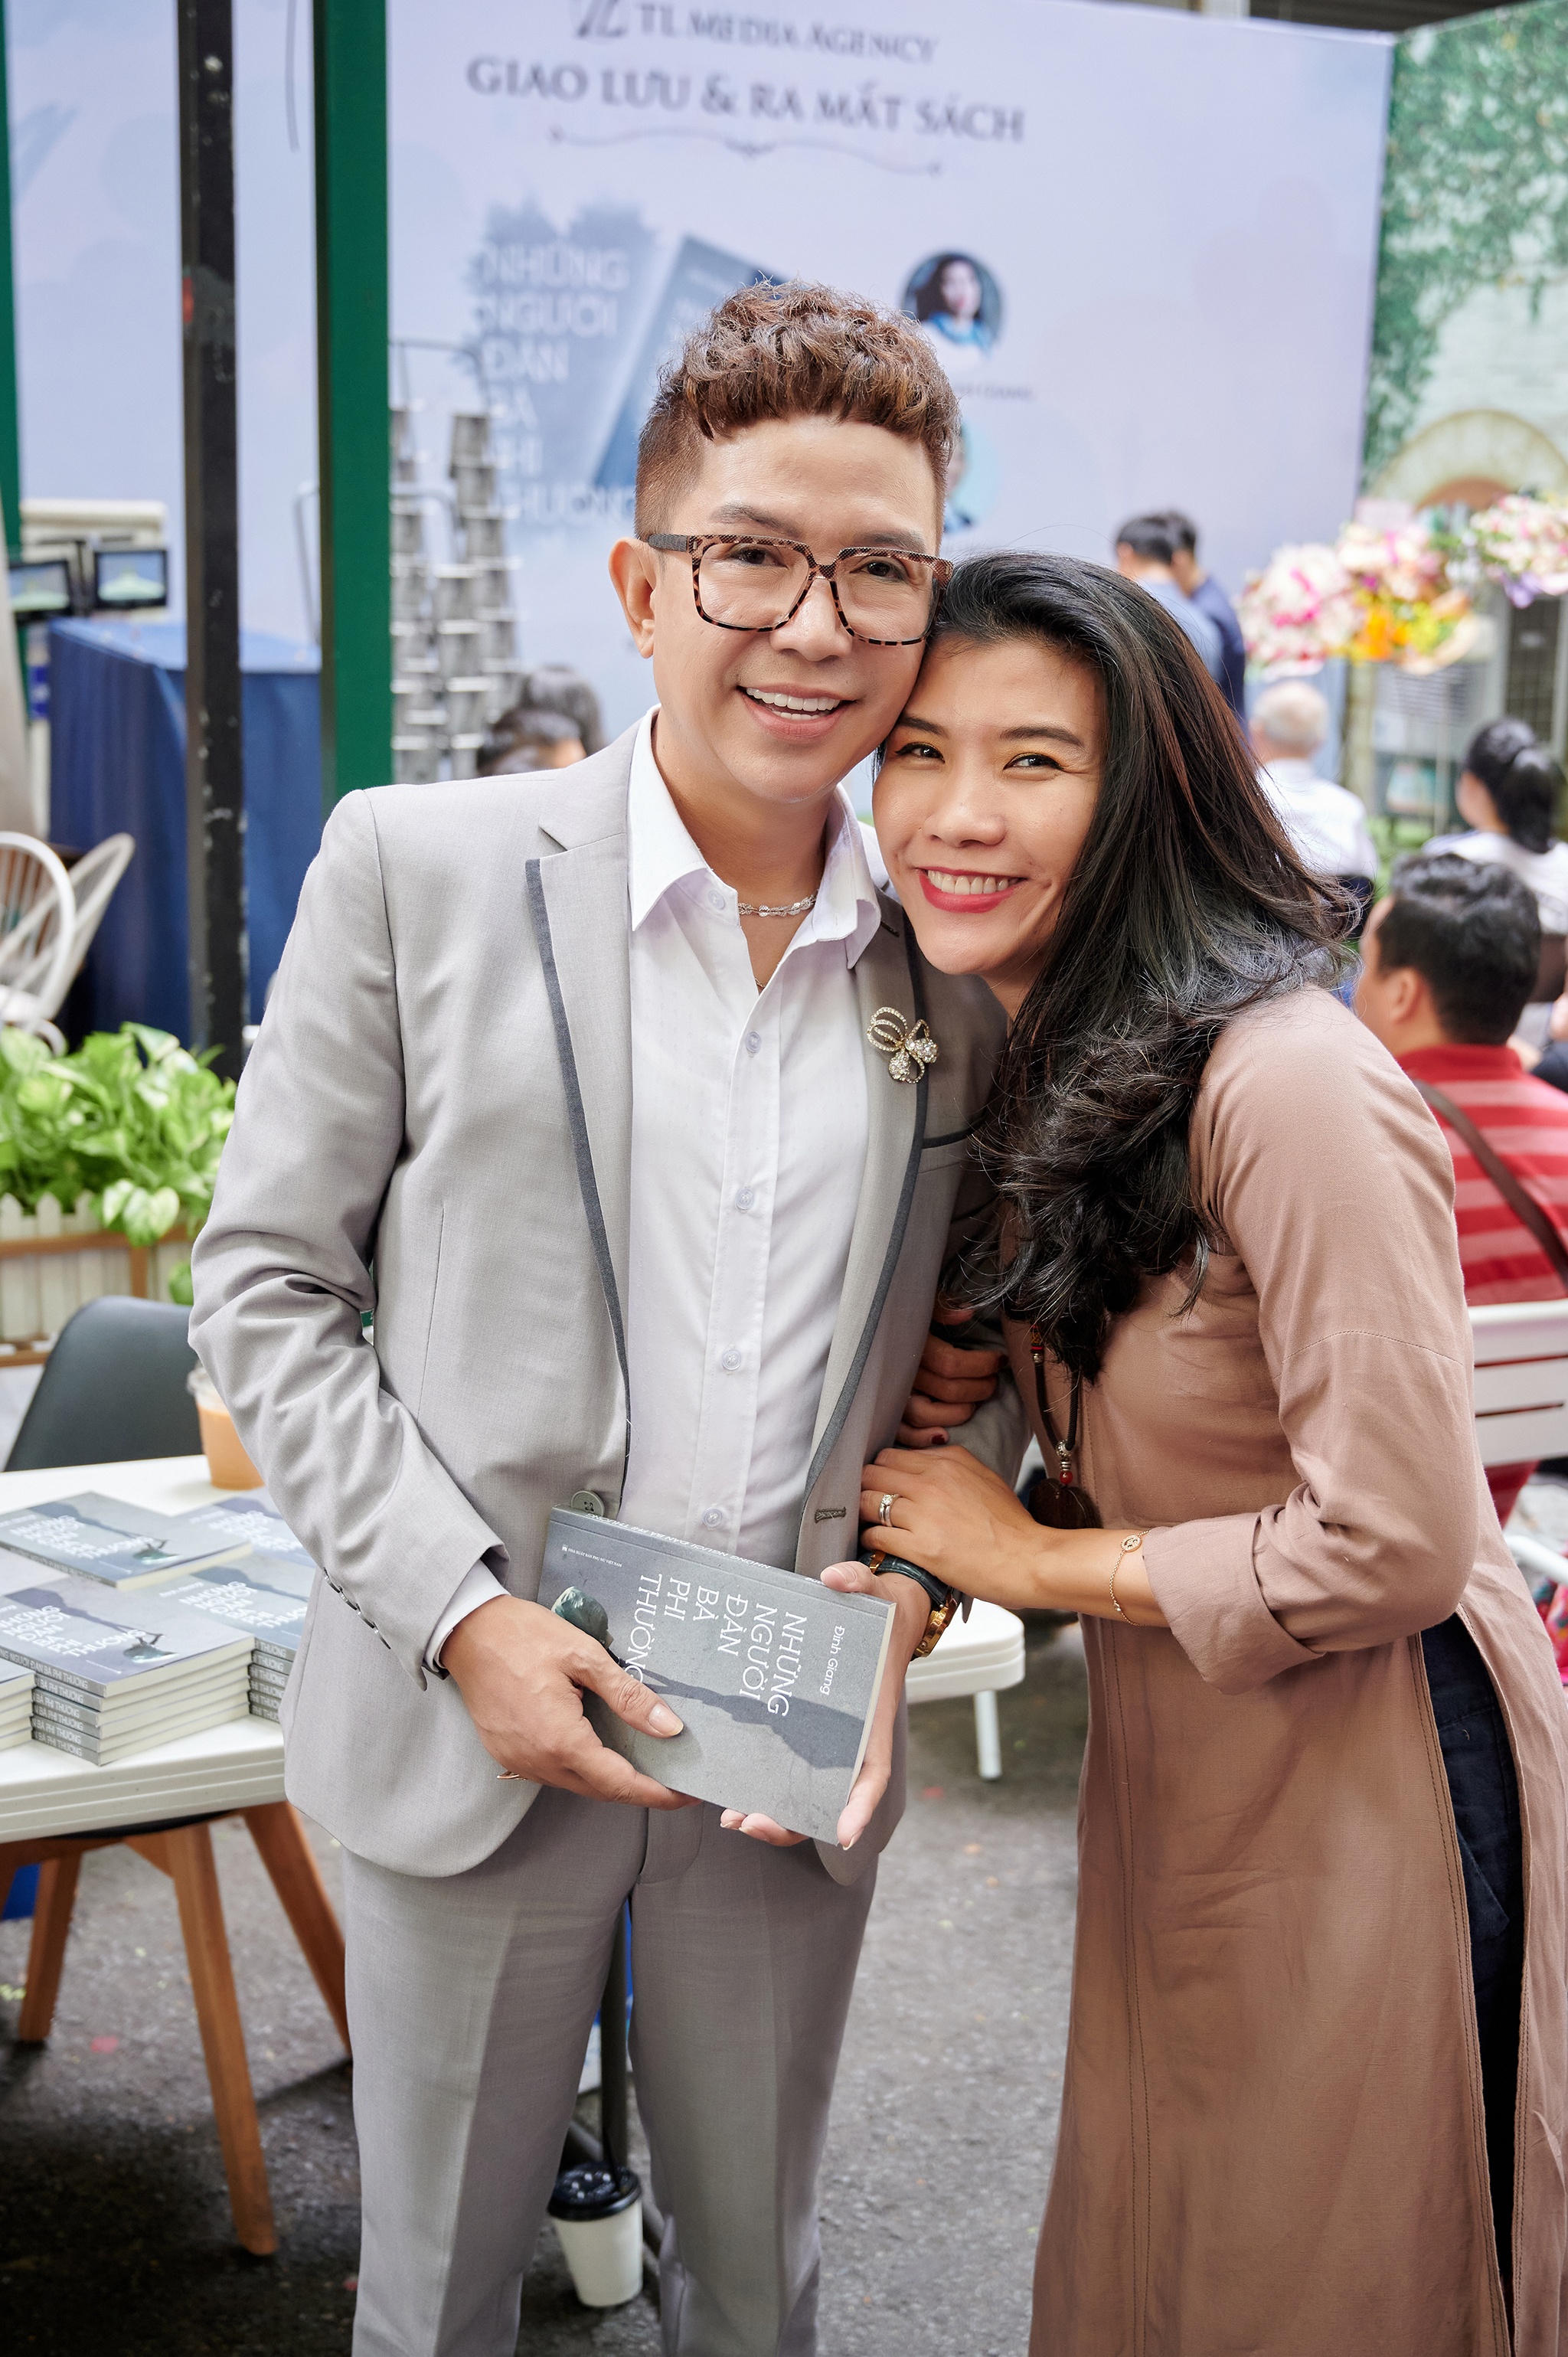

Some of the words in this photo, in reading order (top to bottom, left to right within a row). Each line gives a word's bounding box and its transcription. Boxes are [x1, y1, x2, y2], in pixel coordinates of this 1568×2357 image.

[688, 11, 800, 47] MEDIA
[805, 21, 940, 64] AGENCY
[466, 54, 590, 103] GIAO
[701, 72, 737, 116] &
[750, 80, 805, 123] RA
[664, 1577, 691, 1621] PHI
[693, 1585, 720, 1621] BÀ
[717, 1594, 748, 1656] ĐÀN
[739, 1603, 778, 1700] NGƯỜI
[767, 1612, 807, 1717] NHỮNG
[831, 1625, 845, 1655] Đinh
[820, 1658, 838, 1695] Giang
